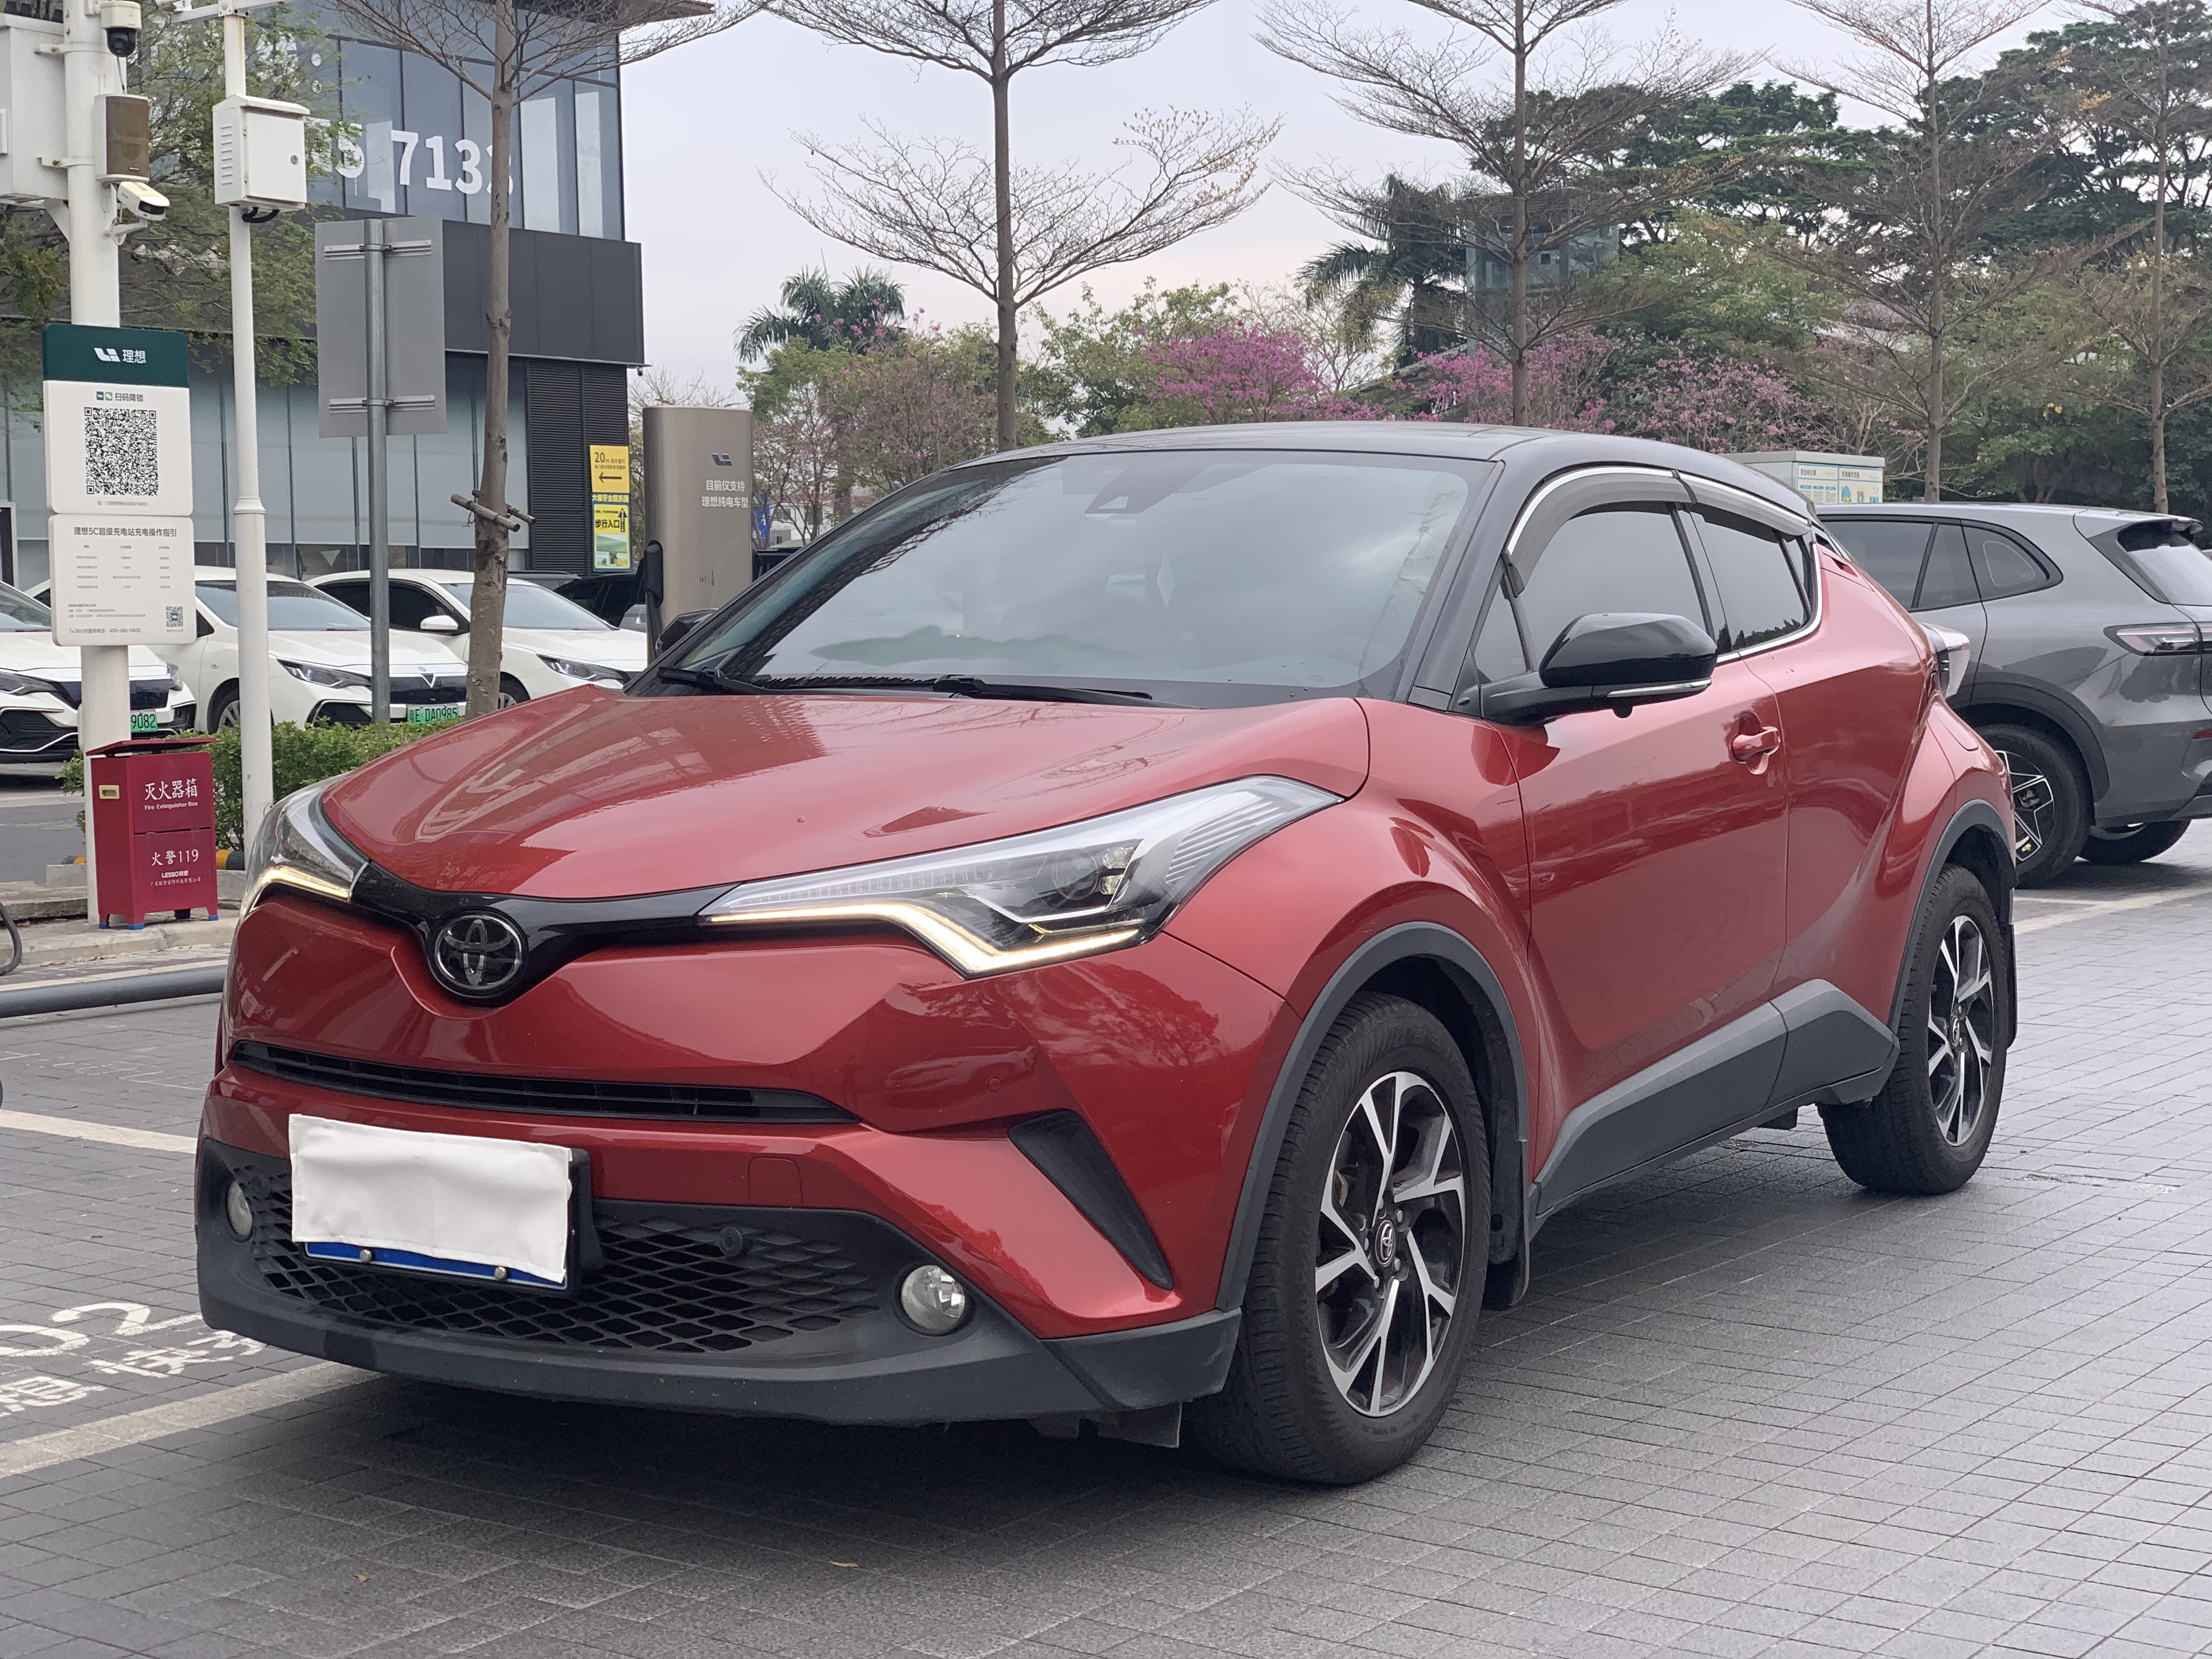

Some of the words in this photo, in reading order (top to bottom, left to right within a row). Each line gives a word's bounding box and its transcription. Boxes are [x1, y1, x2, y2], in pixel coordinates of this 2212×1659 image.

[122, 349, 146, 364] 理想
[115, 393, 144, 402] 扫码降锁
[706, 479, 745, 492] 目前仅支持
[702, 496, 748, 508] 理想纯电车型
[595, 519, 620, 528] 步行入口
[74, 527, 177, 537] 理想5C超级充电站充电操作指引
[131, 714, 156, 729] 9082
[144, 778, 198, 800] 灭火器箱
